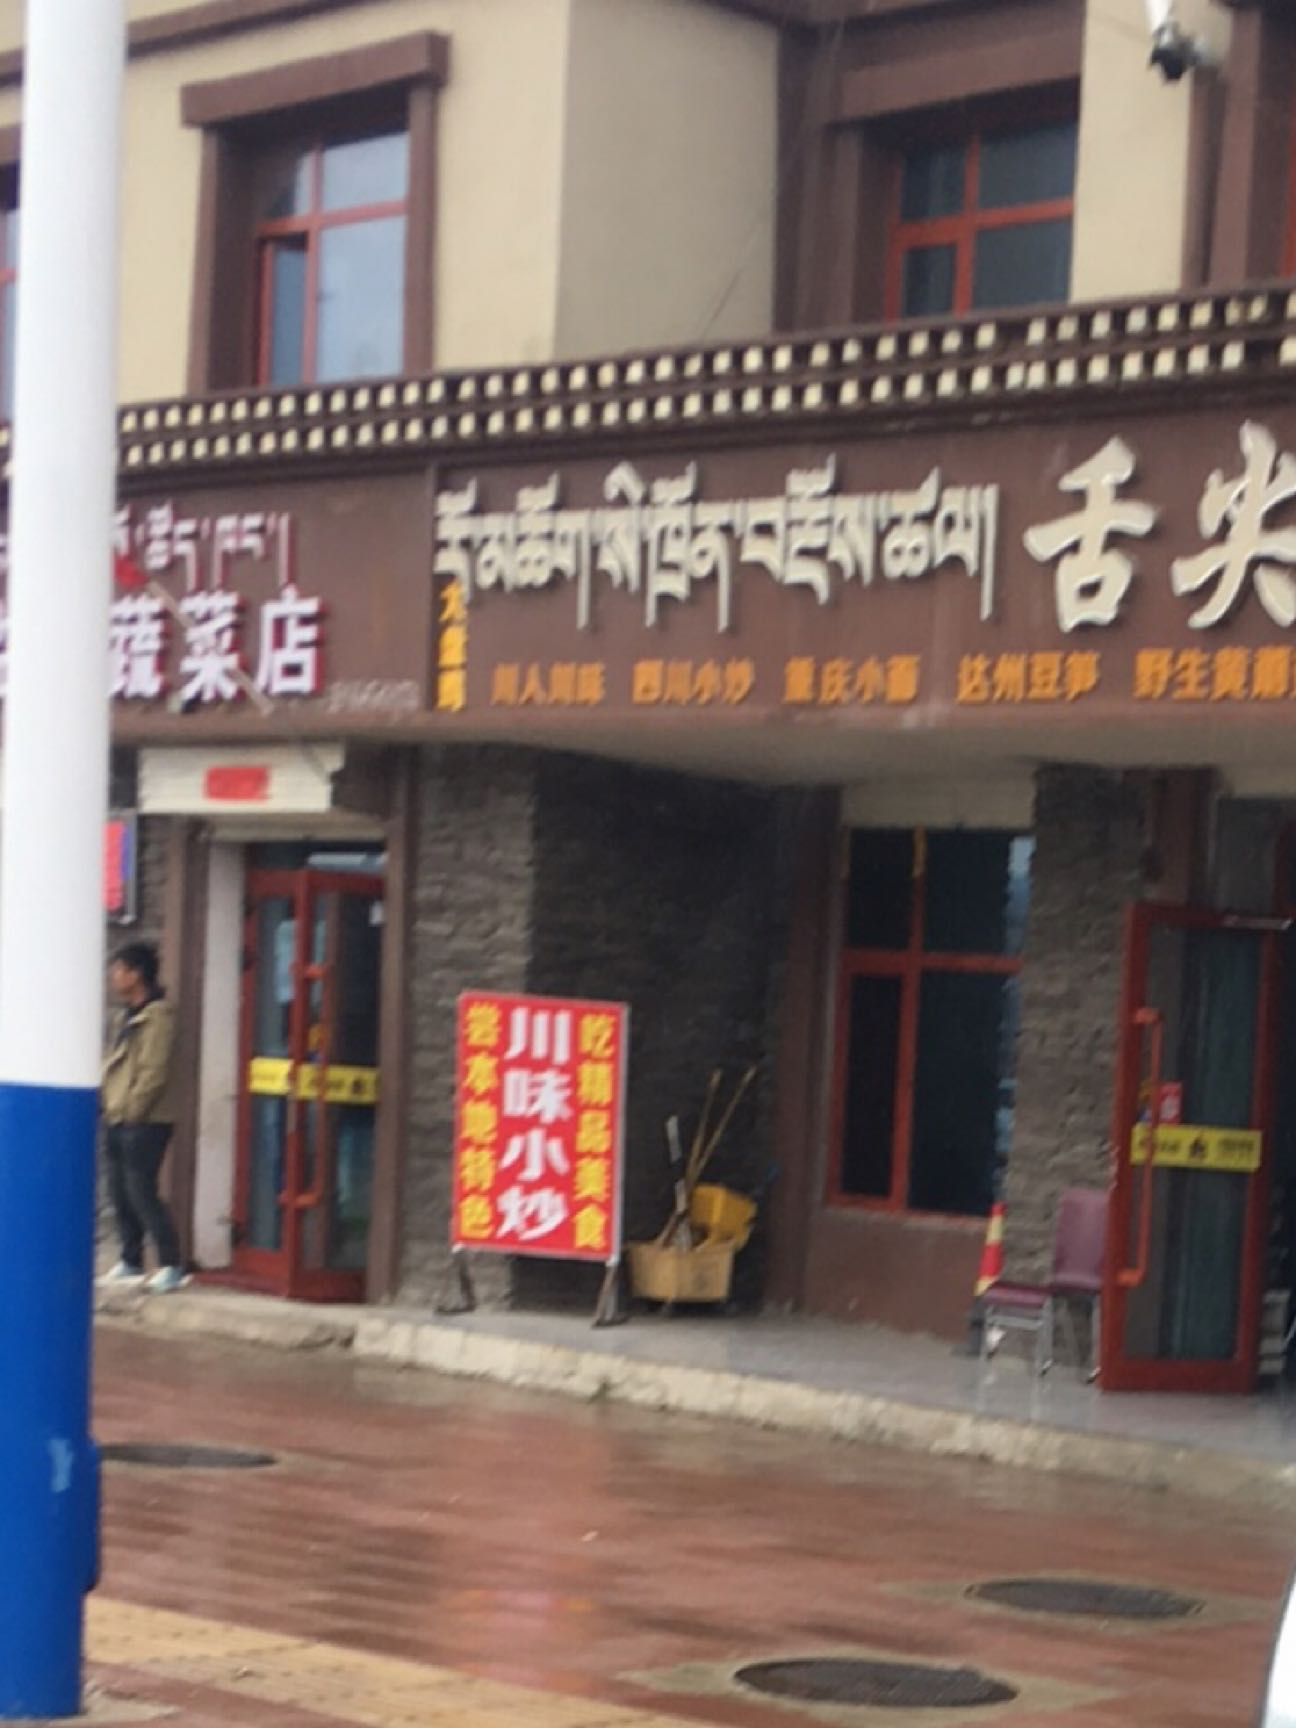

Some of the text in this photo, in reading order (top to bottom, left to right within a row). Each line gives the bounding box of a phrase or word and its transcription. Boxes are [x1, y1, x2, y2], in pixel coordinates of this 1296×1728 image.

[108, 584, 322, 702] 蔬菜店
[496, 1006, 573, 1241] 川味小炒
